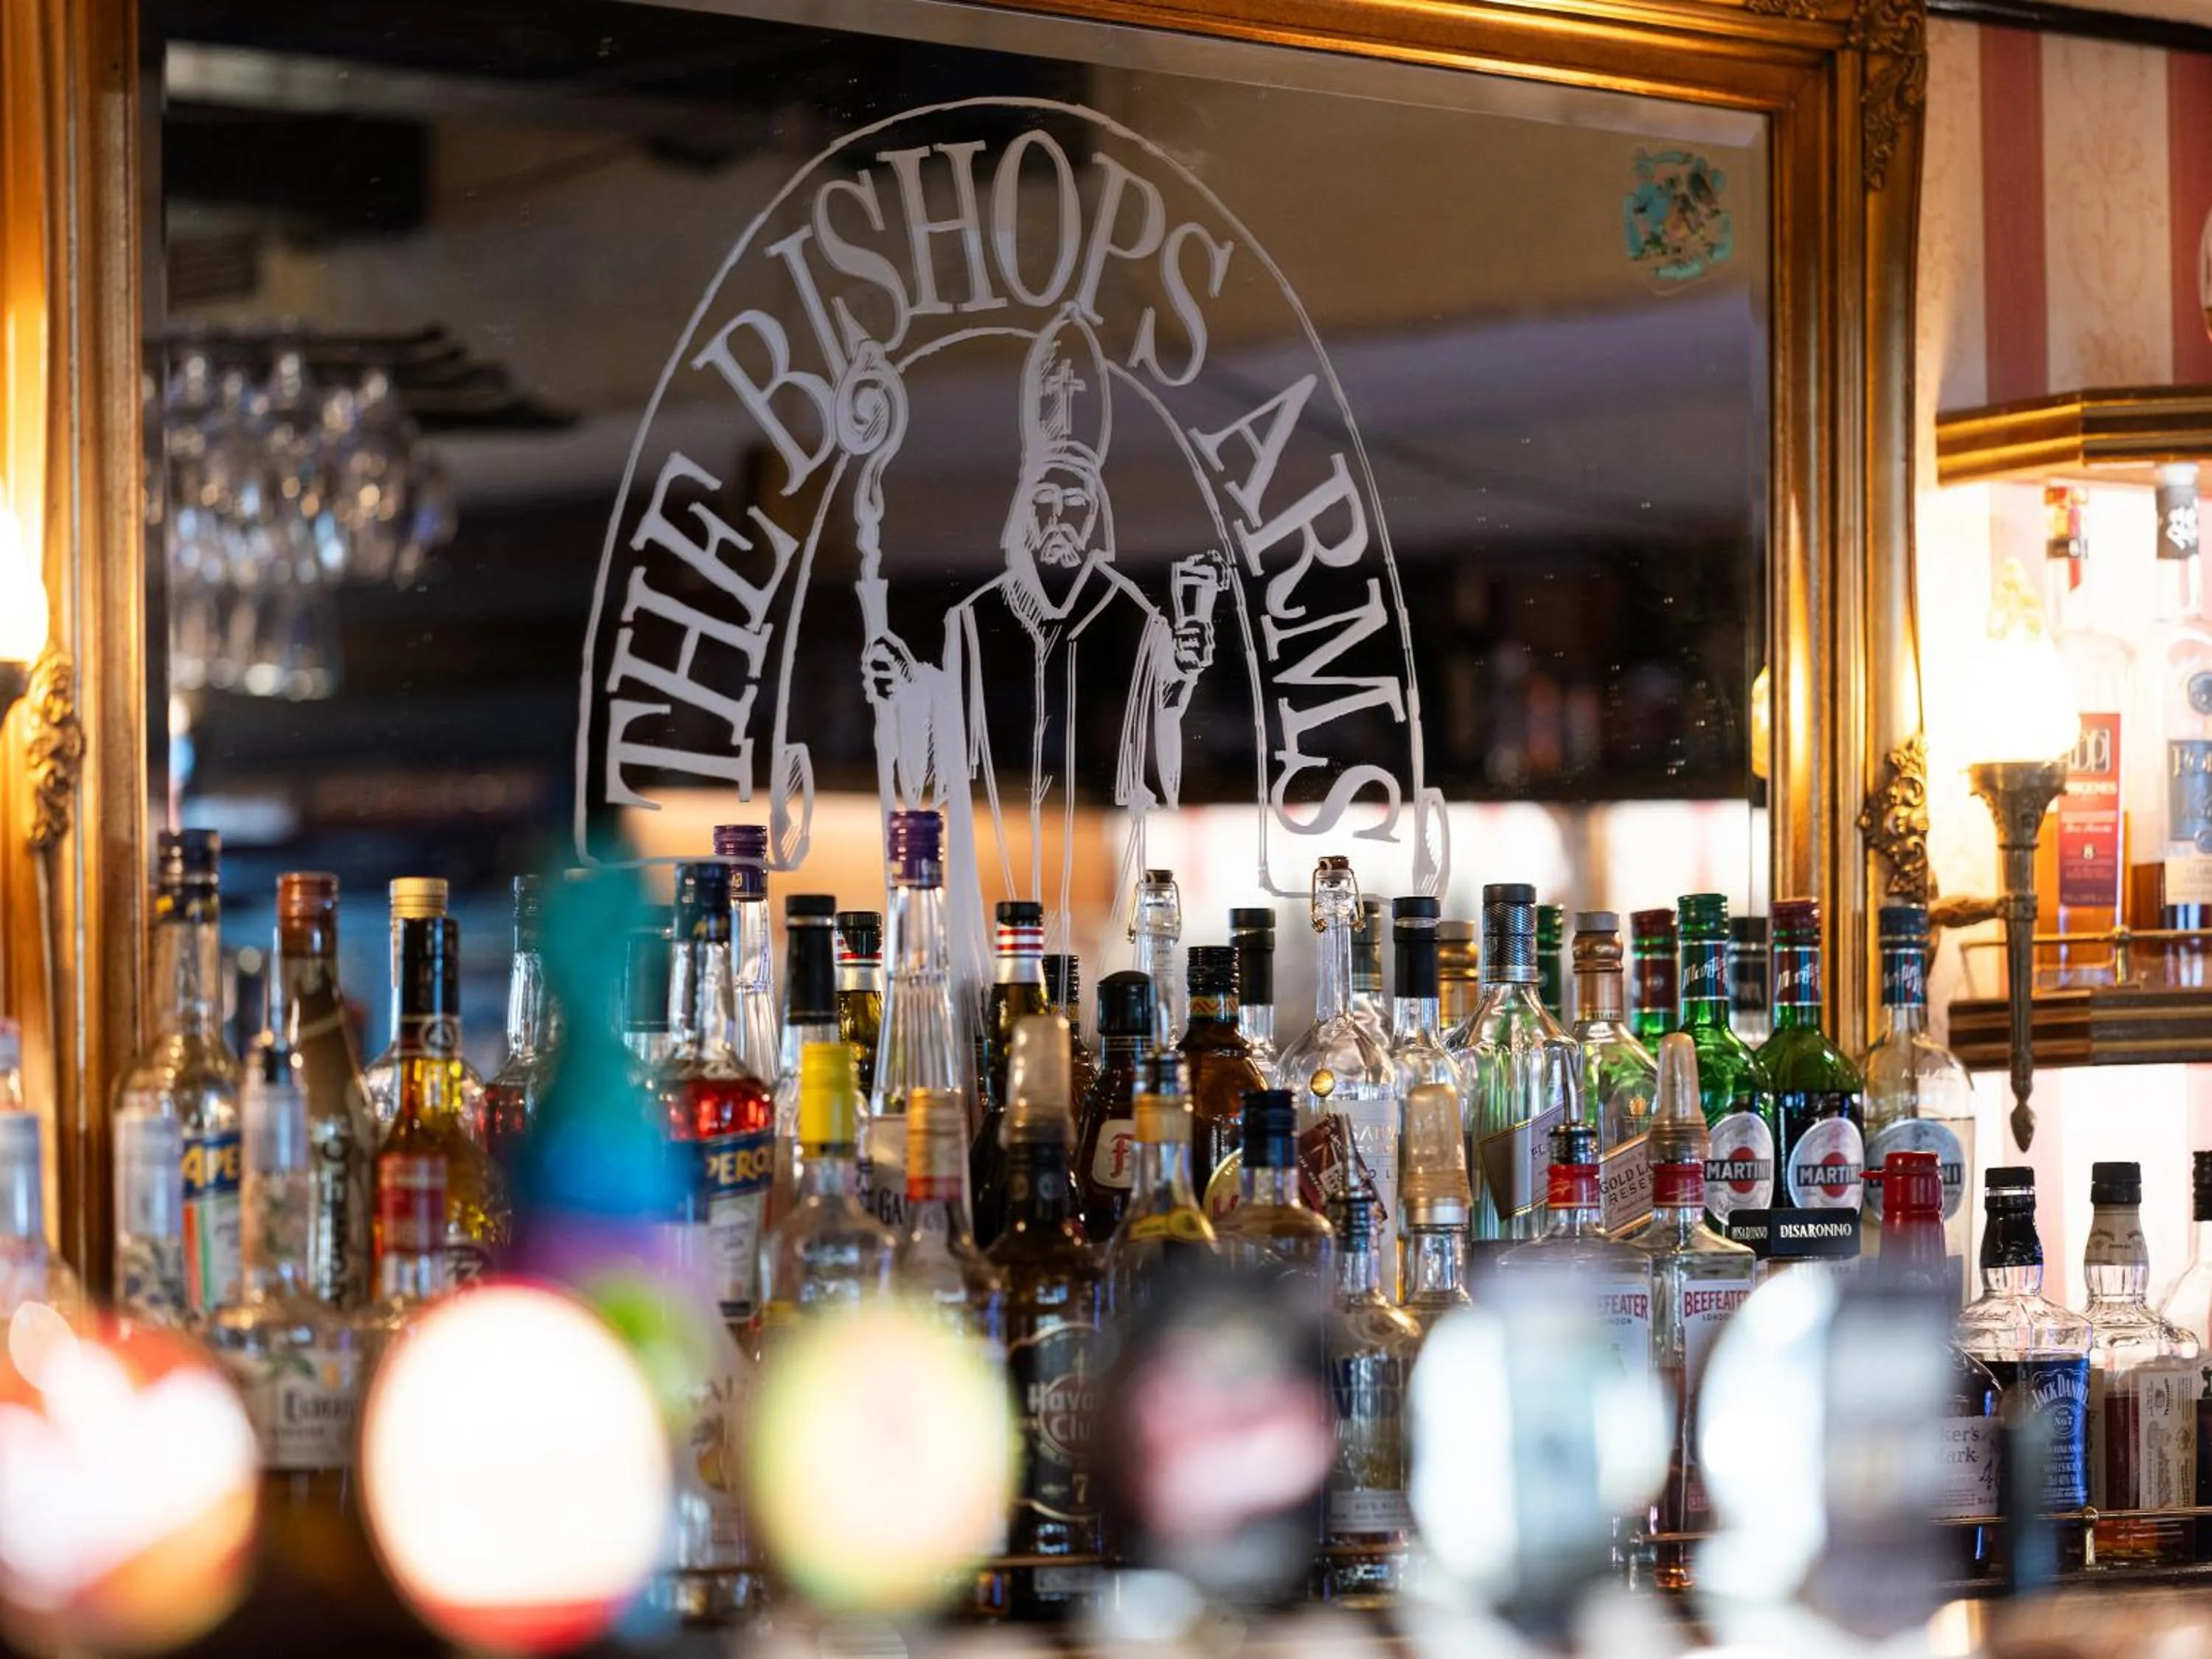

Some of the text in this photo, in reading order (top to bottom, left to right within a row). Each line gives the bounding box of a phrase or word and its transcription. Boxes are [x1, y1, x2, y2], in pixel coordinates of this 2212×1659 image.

[605, 129, 1407, 845] THE BISHOPS ARMS
[1706, 1161, 1770, 1180] MARTINI
[1799, 1165, 1861, 1185] MARTINI
[1779, 1223, 1852, 1239] DISARONNO
[1027, 1381, 1095, 1412] Hava
